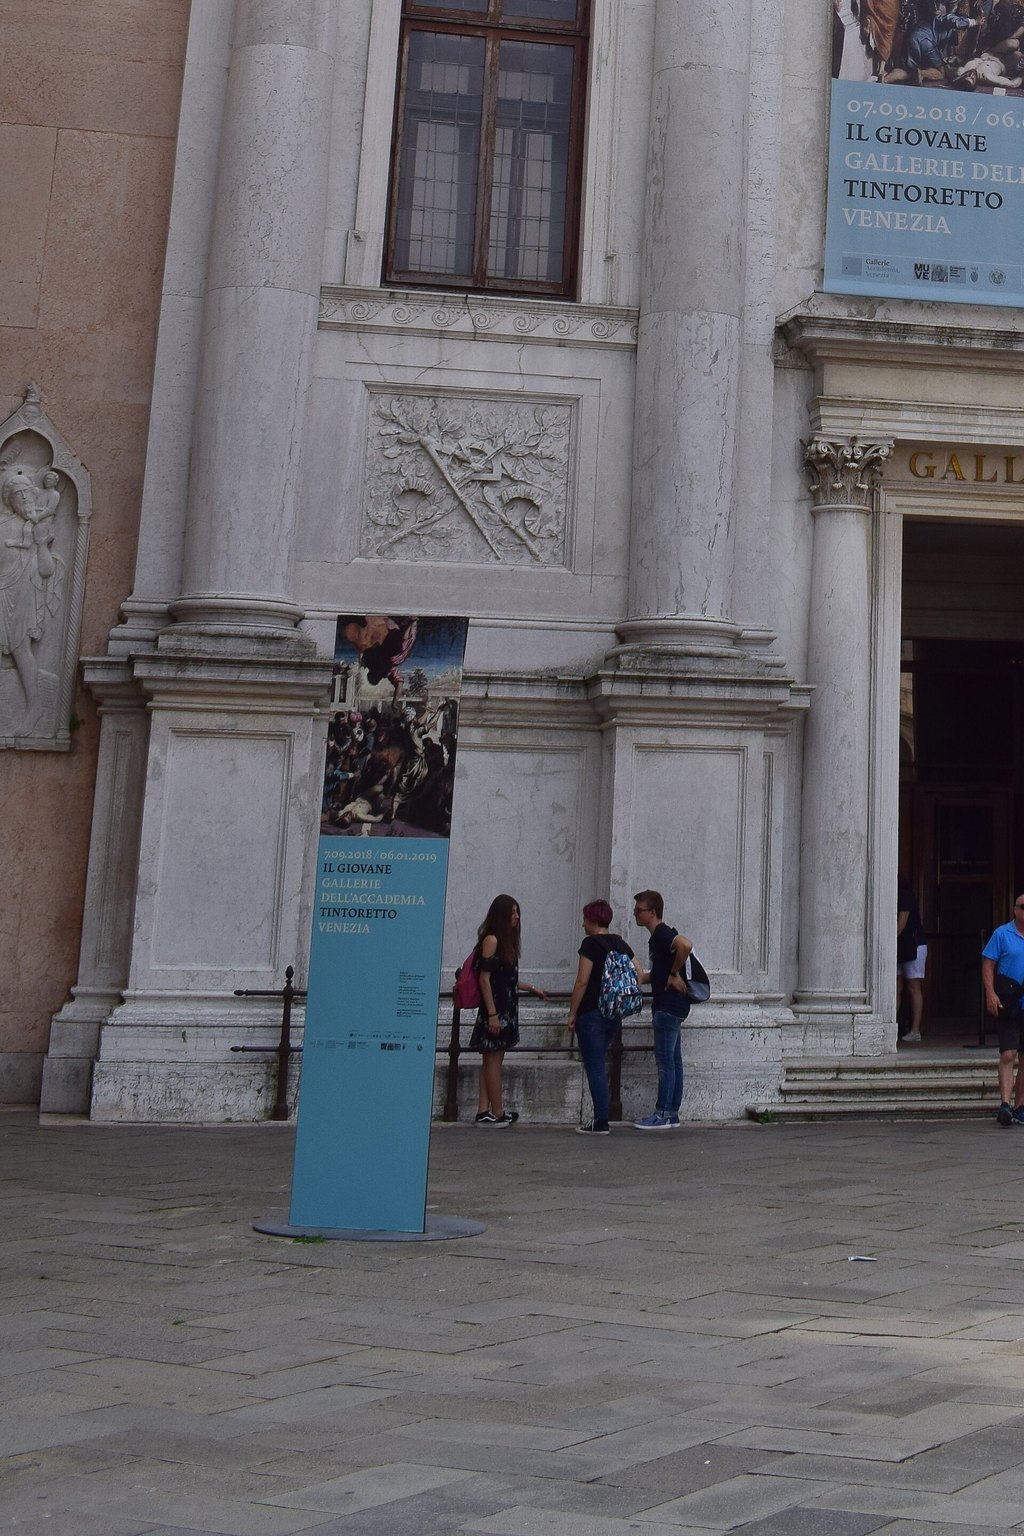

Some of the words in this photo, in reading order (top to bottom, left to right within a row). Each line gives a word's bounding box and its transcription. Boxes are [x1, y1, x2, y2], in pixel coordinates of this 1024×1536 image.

[847, 99, 967, 123] 07.09.2018
[845, 123, 869, 141] IL
[875, 126, 987, 152] GIOVANE
[844, 151, 964, 178] GALLERIE
[844, 179, 1003, 210] TINTORETTO
[842, 208, 951, 234] VENEZIA
[865, 258, 890, 267] Gallerie
[324, 849, 373, 861] 7.09.2018
[380, 850, 437, 863] 06.01.2019
[323, 863, 335, 873] IL
[337, 864, 392, 874] GIOVANE
[321, 878, 381, 889] GALLERIE
[319, 907, 397, 919] TINTORETTO
[318, 922, 371, 933] VENEZIA
